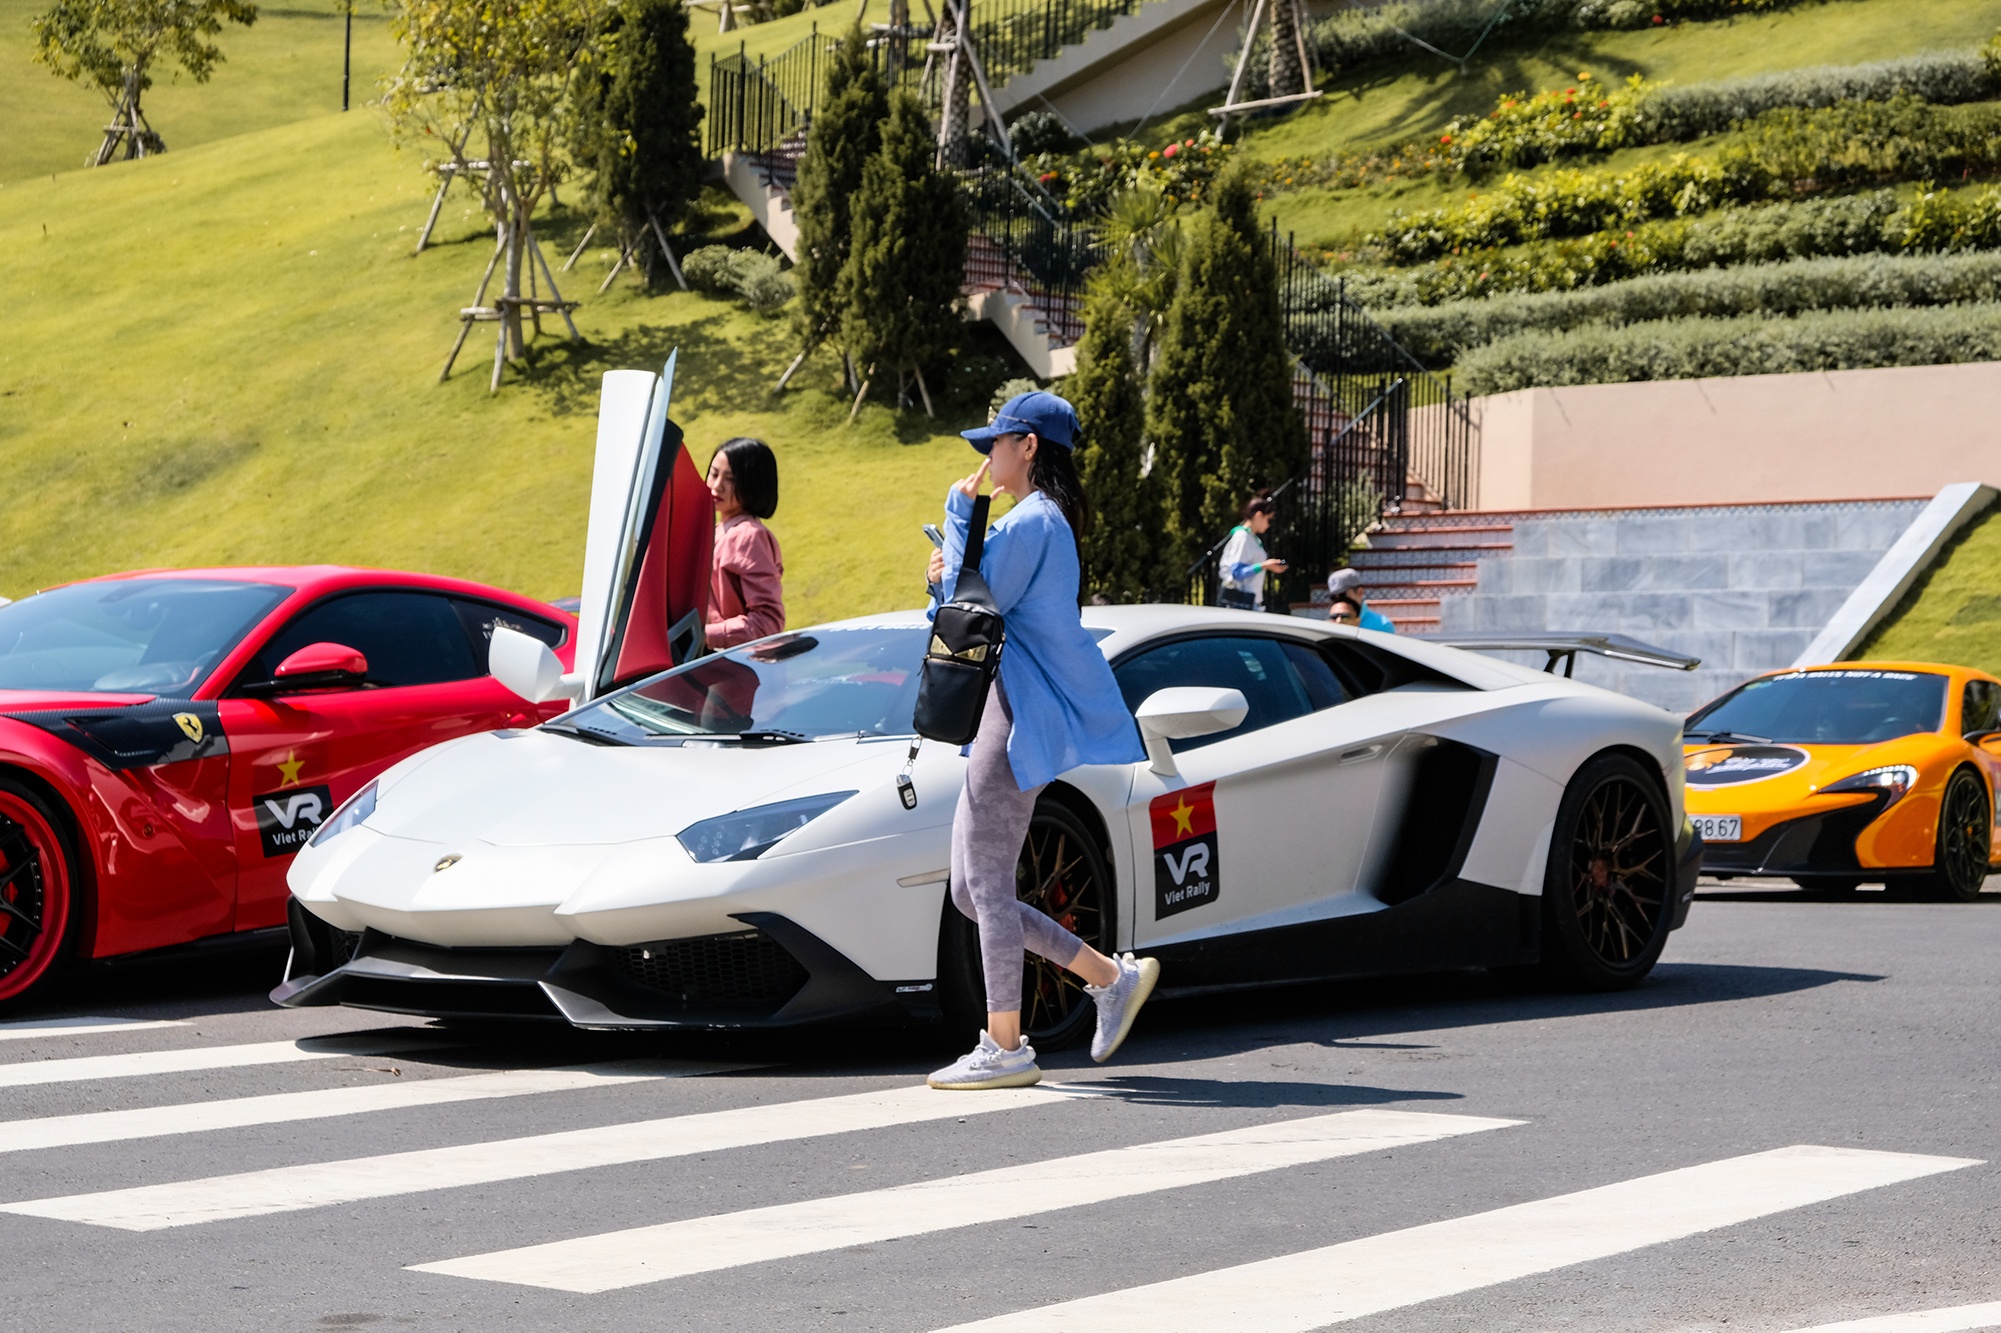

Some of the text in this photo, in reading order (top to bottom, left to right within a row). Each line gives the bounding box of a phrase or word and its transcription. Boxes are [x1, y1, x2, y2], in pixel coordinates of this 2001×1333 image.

[264, 792, 322, 829] VR
[272, 832, 297, 846] Viet
[1163, 842, 1210, 886] VR
[1165, 881, 1211, 905] Viet Rally
